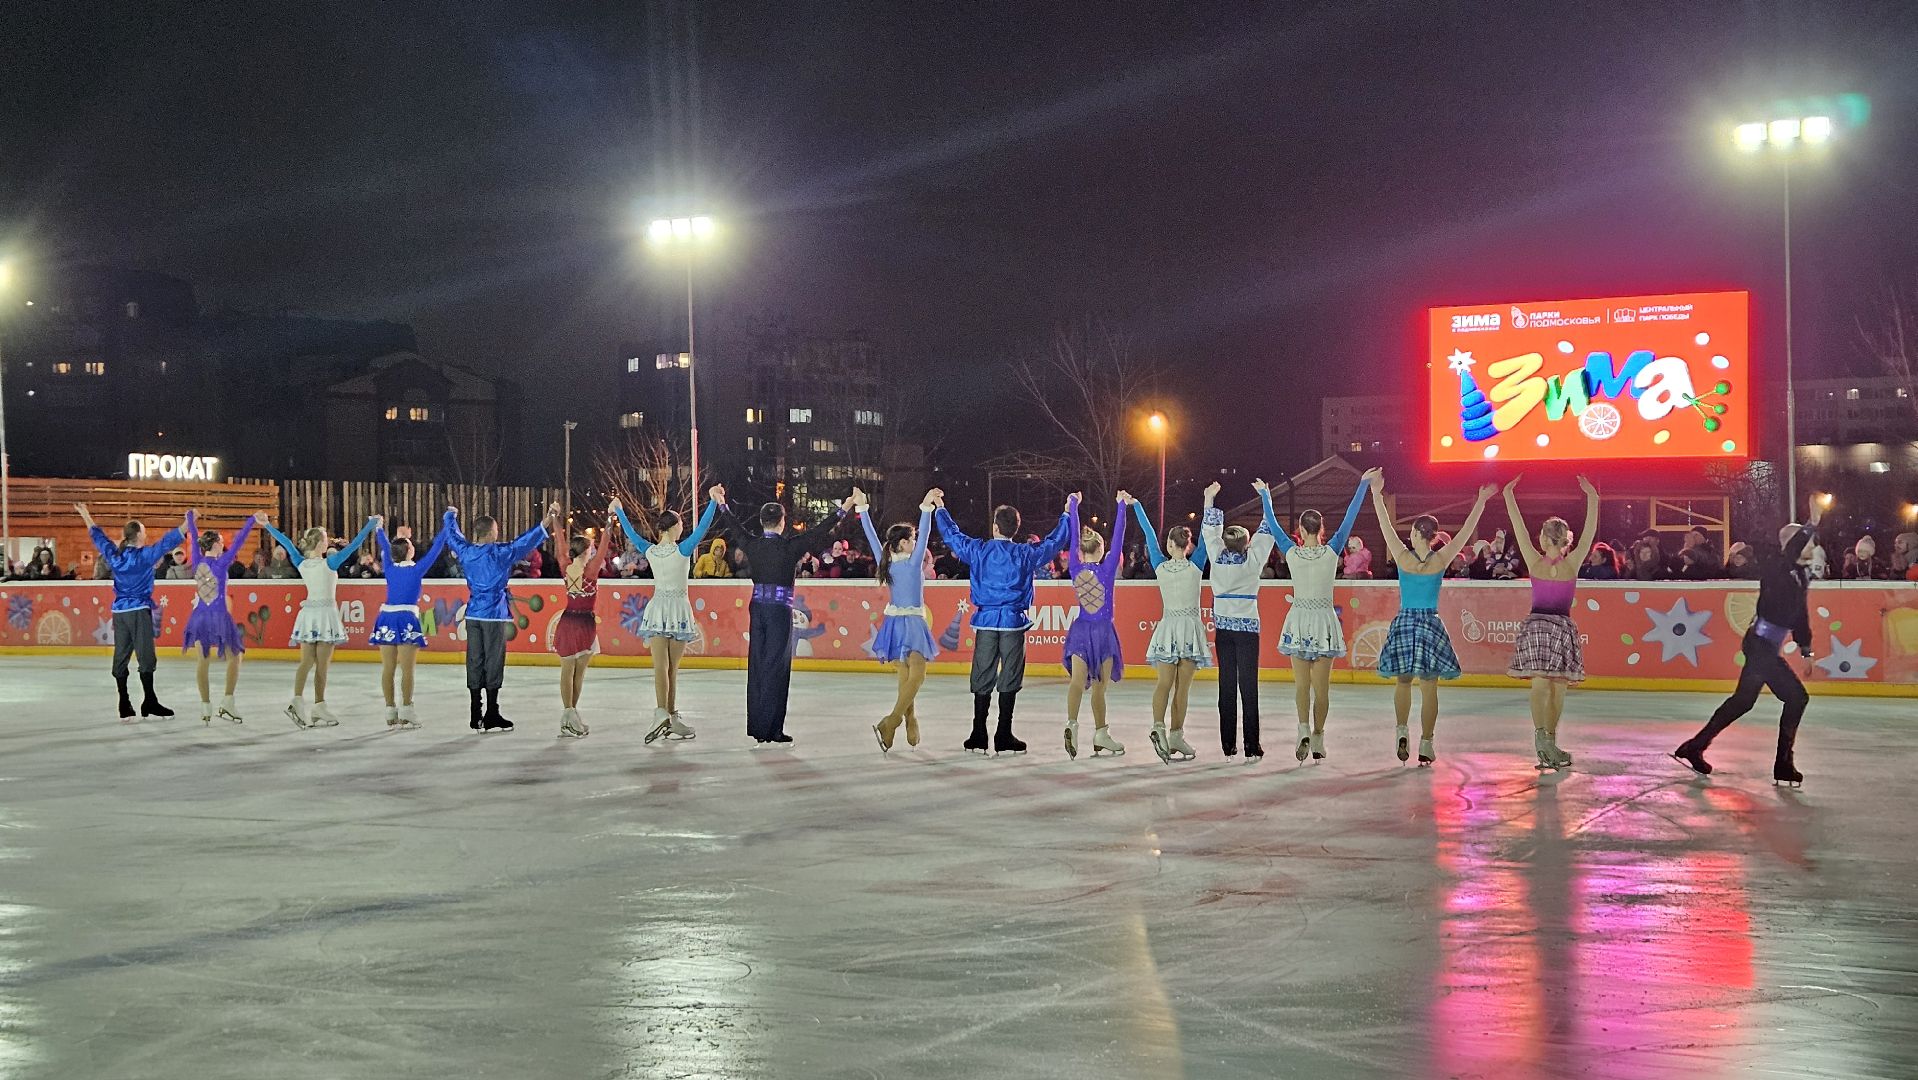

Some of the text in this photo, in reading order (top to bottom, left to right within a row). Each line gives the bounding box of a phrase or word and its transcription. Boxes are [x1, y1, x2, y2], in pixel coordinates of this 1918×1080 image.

[1530, 311, 1560, 320] ПАРКИ
[1530, 316, 1601, 328] ПОДМОСКОВЬЯ
[128, 453, 218, 481] ПРОКАТ
[1487, 620, 1521, 631] ПАРК
